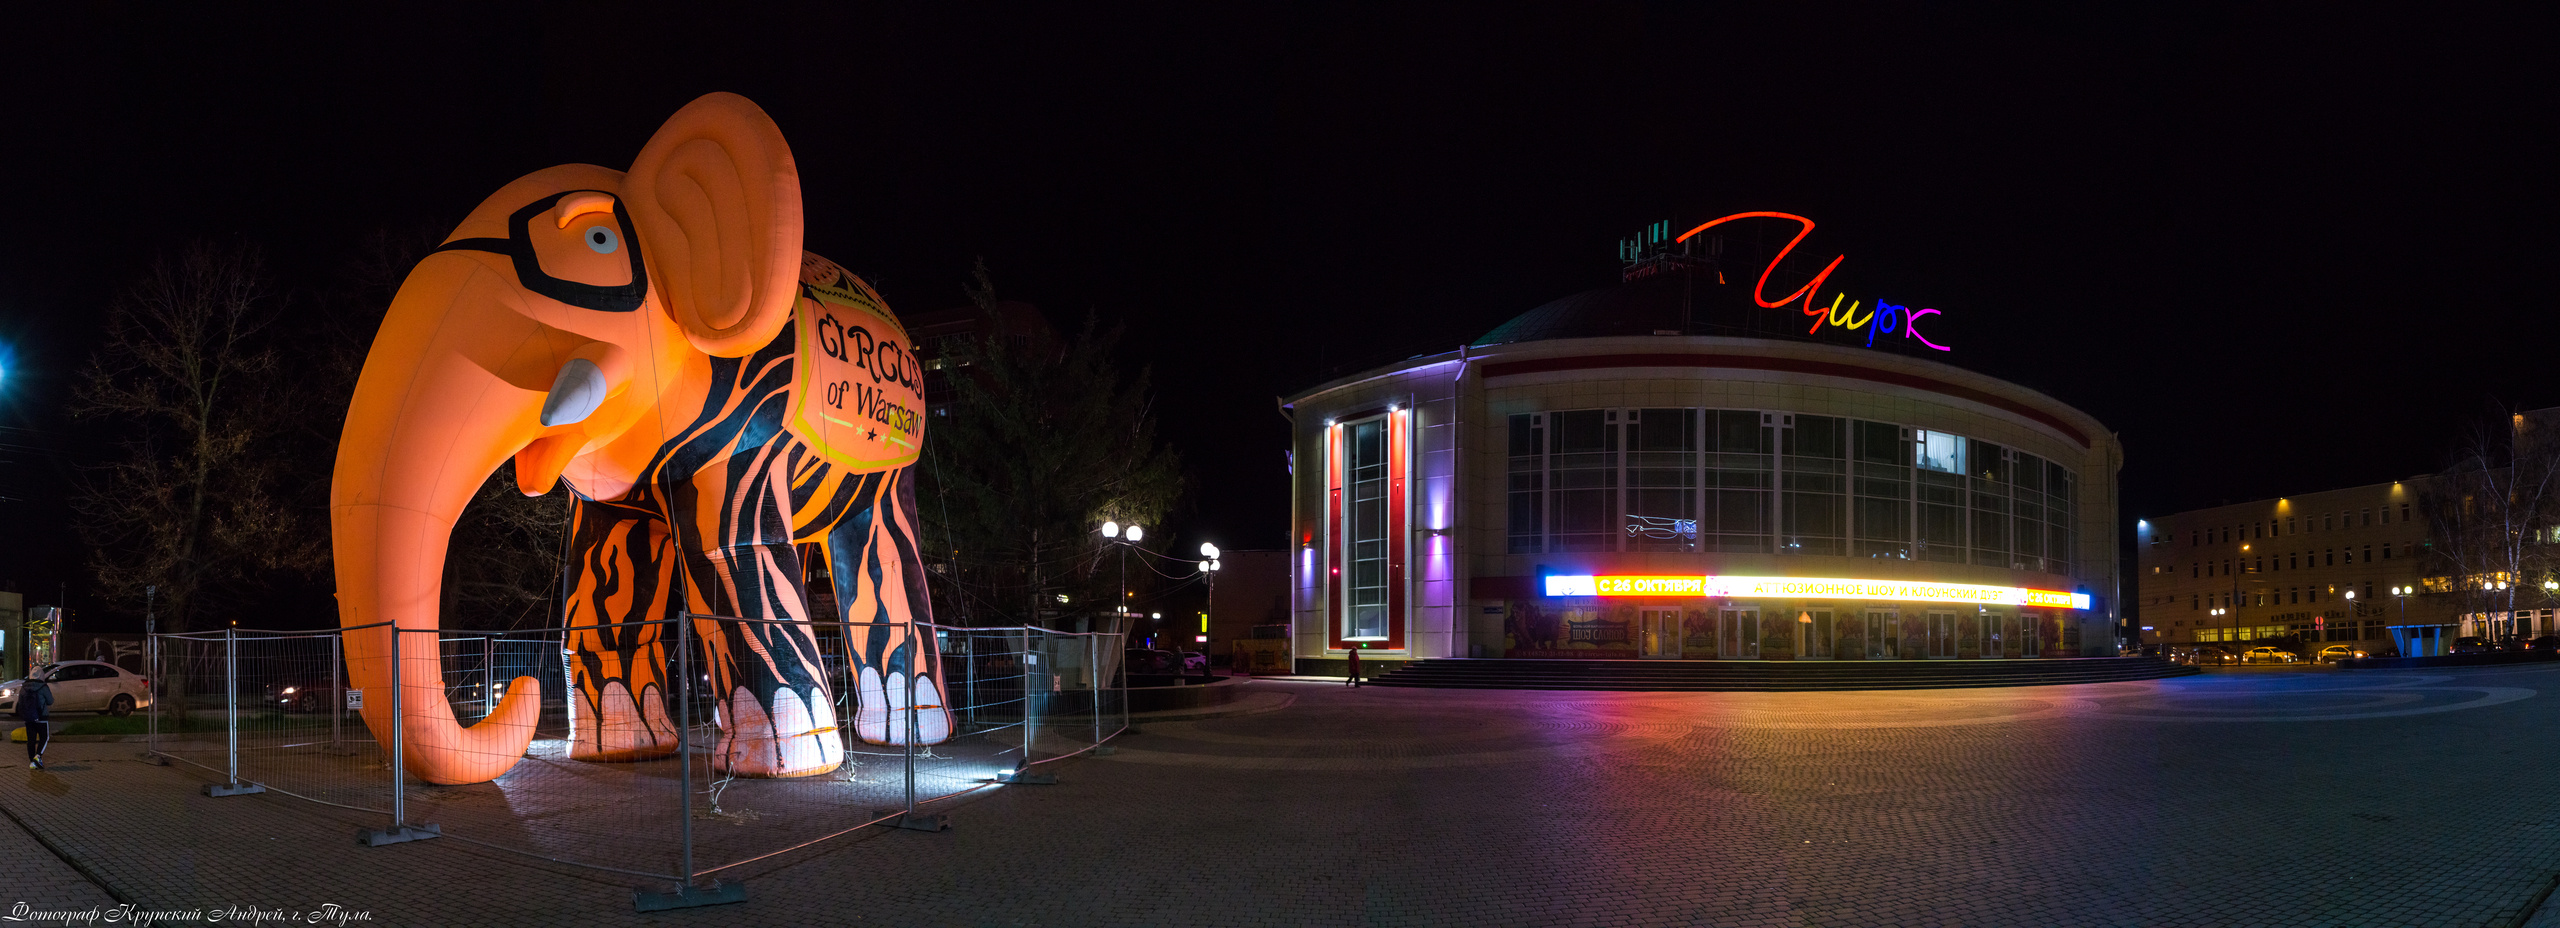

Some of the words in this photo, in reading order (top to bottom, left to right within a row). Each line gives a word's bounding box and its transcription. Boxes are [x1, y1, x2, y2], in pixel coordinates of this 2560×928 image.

[1676, 211, 1951, 352] Цирк
[818, 313, 923, 400] CIRCUS
[827, 380, 849, 410] of
[856, 382, 923, 439] Warsaw
[1599, 579, 1610, 592] С
[1613, 579, 1631, 592] 26
[1634, 579, 1701, 592] ОКТЯБРЯ
[1867, 584, 1895, 596] ШОУ
[1900, 586, 1908, 597] И
[1912, 586, 1976, 598] КЛОУНСКИЙ
[1980, 589, 2003, 600] ДУЭТ
[1573, 629, 1591, 640] ШОУ
